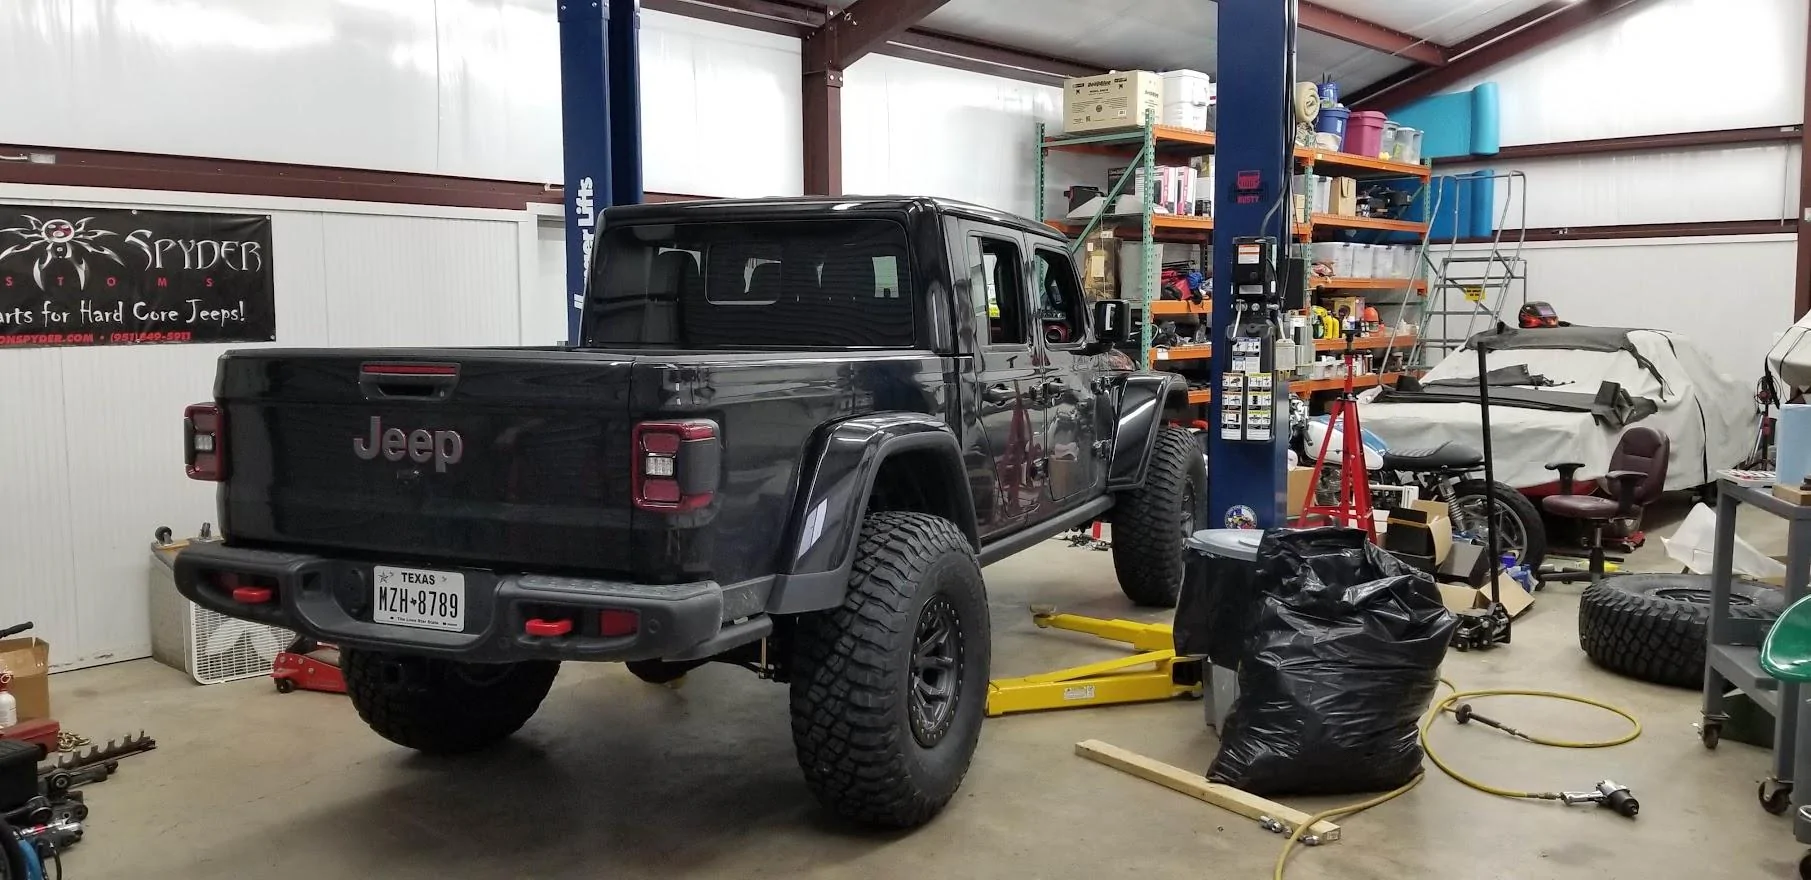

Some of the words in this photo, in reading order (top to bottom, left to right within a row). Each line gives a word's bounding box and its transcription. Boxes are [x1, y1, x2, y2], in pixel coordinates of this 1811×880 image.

[576, 177, 594, 227] Lifts
[41, 300, 71, 327] for
[80, 299, 123, 324] Hard
[133, 301, 179, 322] Core
[185, 299, 245, 327] Jeeps!
[353, 415, 462, 472] Jeep
[401, 572, 436, 585] TEXAS
